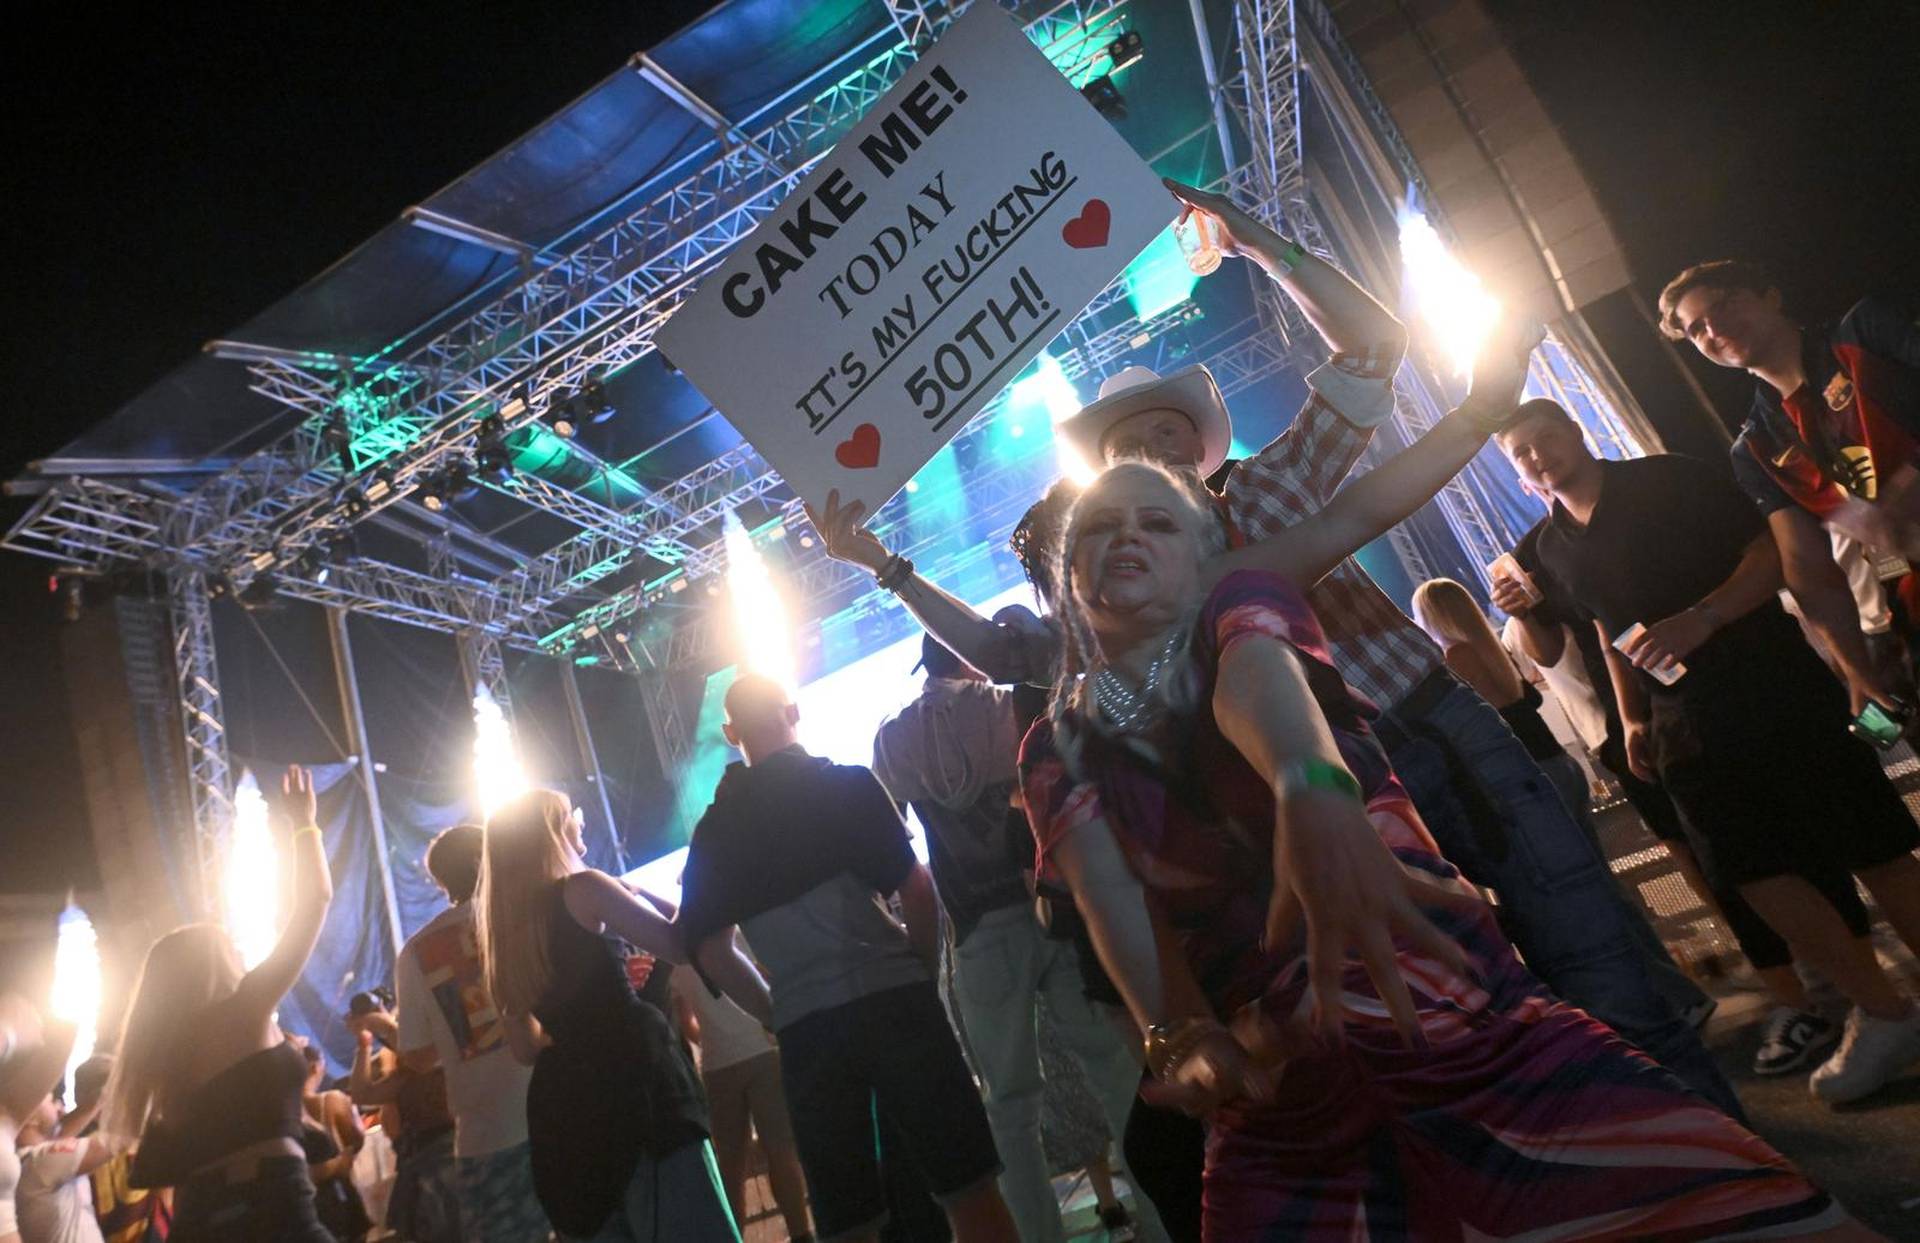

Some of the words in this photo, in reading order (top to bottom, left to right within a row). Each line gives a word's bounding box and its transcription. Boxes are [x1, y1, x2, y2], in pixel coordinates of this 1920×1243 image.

[721, 167, 868, 319] CAKE
[857, 64, 969, 179] ME!
[794, 351, 868, 430] IT'S
[871, 293, 917, 360] MY
[921, 150, 1068, 305] FUCKING
[817, 170, 957, 320] TODAY
[903, 265, 1052, 420] 50TH!
